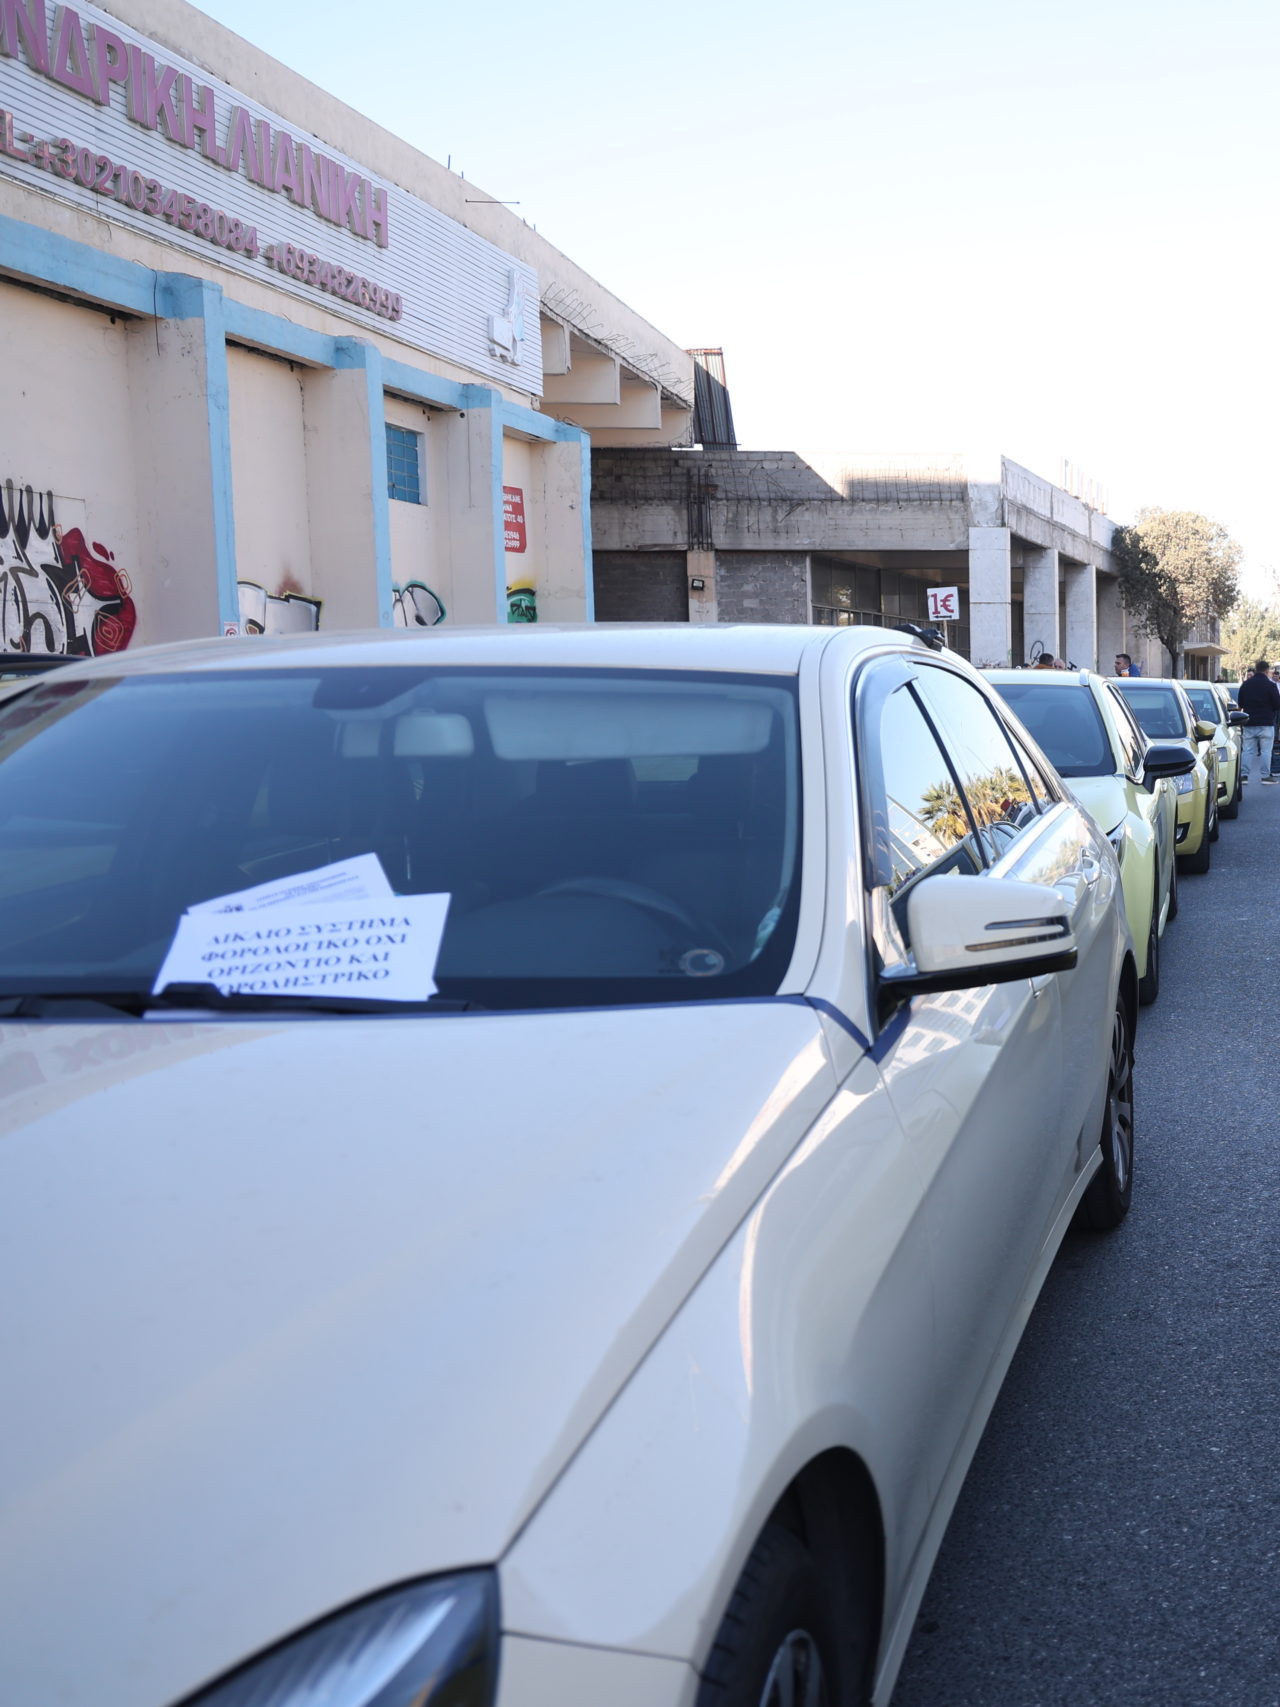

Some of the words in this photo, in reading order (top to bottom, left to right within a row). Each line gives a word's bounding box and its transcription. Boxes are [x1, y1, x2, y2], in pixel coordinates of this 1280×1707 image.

[931, 592, 955, 615] 1€
[208, 928, 291, 945] ΔΙΚΑΙΟ
[298, 917, 411, 935] ΣΥΣΤΗΜΑ
[200, 937, 359, 963] ΦΟΡΟΛΟΓΙΚΟ
[365, 933, 409, 946] ΟΧΙ
[206, 955, 342, 980] ΟΡΙΖΟΝΤΙΟ
[348, 952, 390, 965] ΚΑΙ
[216, 968, 390, 994] ΟΡΟΛΗΣΤΡΙΚΟ
